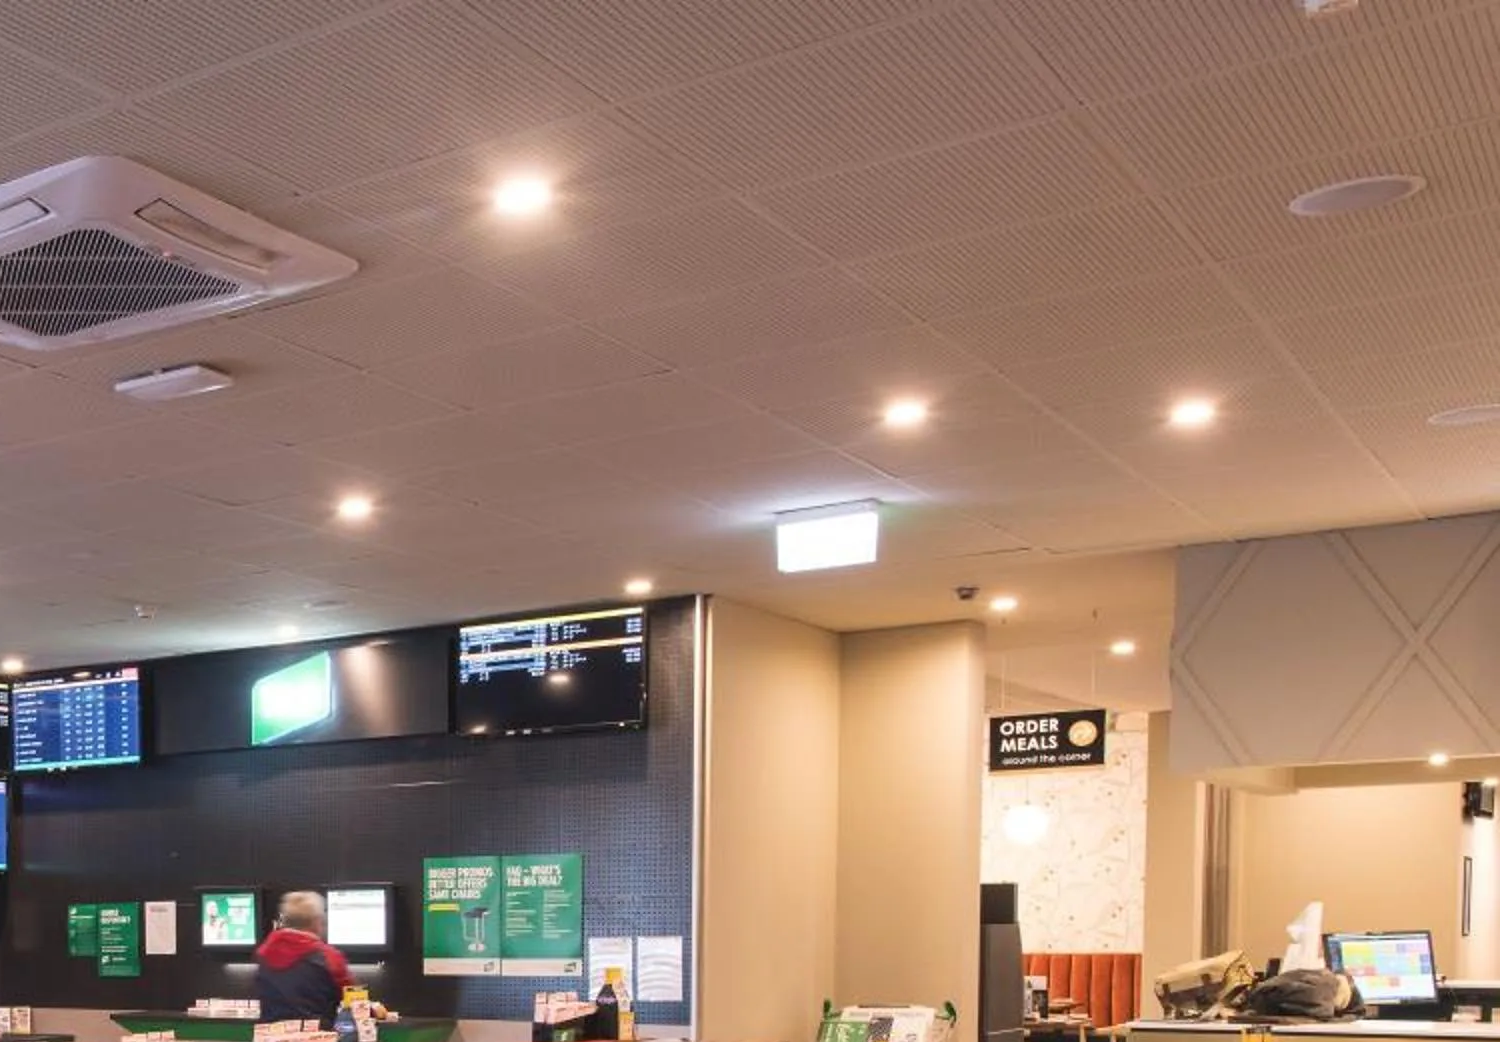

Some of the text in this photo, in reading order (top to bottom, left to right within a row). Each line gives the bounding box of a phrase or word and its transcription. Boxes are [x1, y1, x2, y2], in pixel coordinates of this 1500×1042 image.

[1000, 718, 1059, 735] ORDER
[1000, 735, 1058, 752] MEALS
[1002, 752, 1091, 765] around the corner
